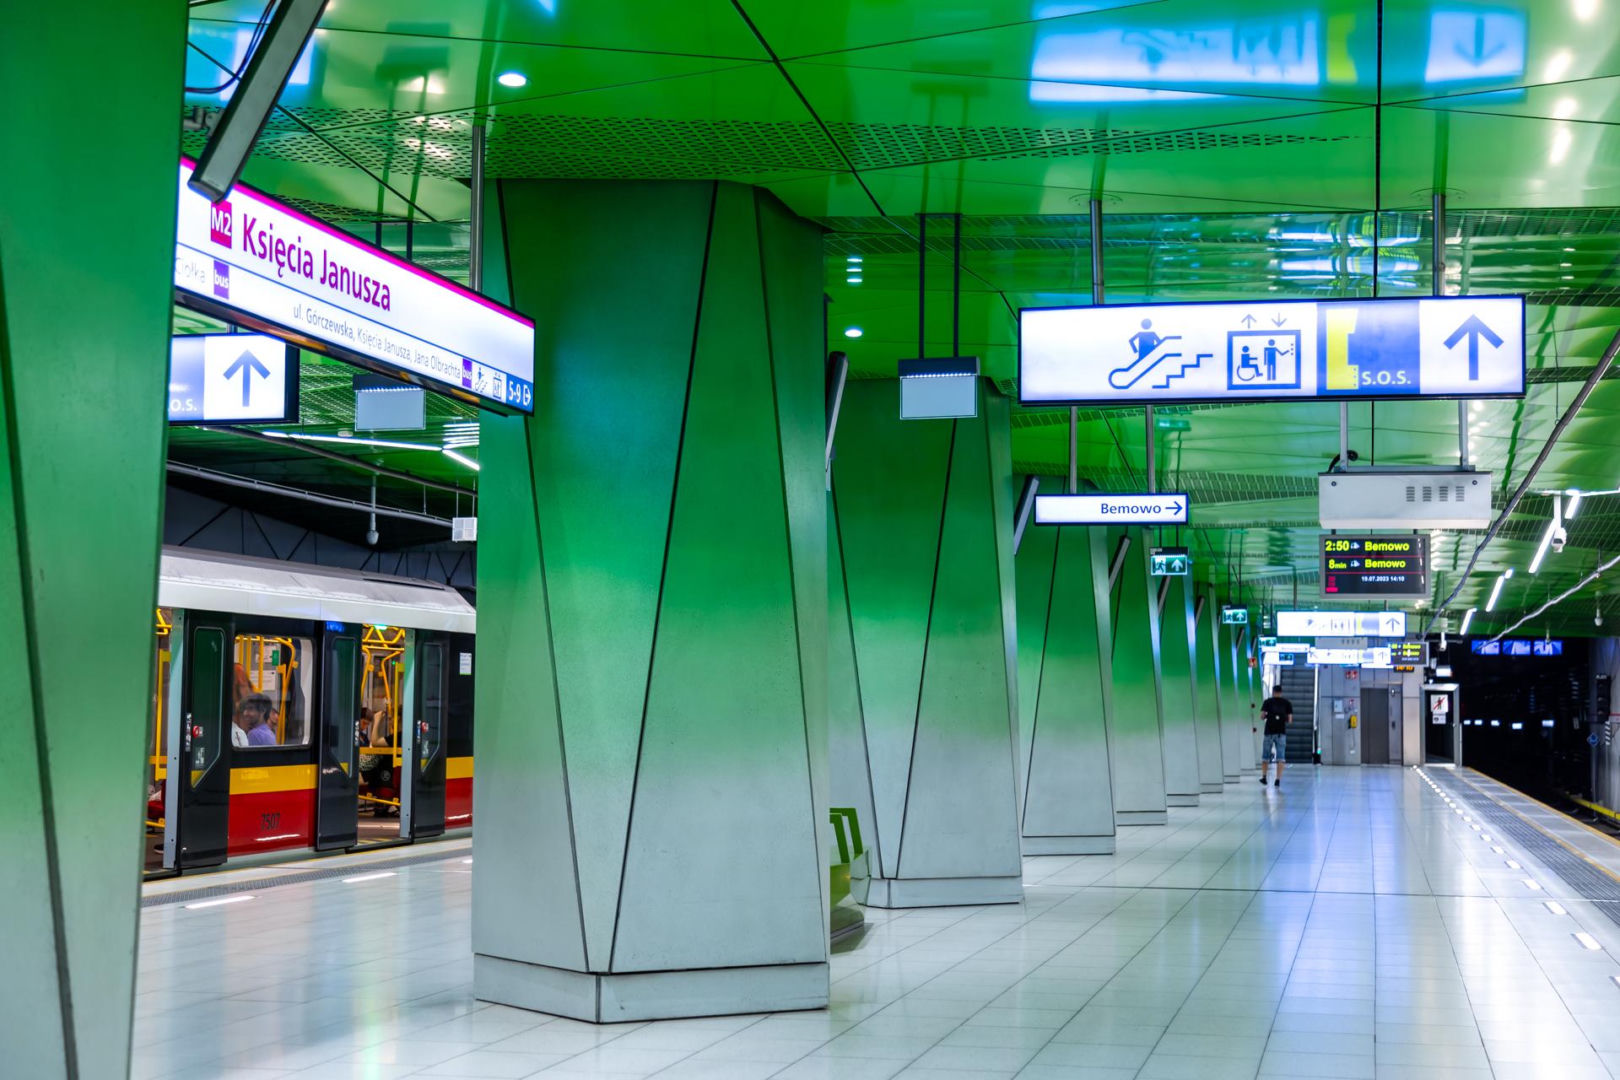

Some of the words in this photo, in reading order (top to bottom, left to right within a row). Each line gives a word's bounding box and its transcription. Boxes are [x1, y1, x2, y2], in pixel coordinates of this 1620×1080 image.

[211, 206, 232, 237] M2
[243, 213, 313, 280] Księcia
[320, 249, 391, 312] Janusza
[213, 268, 230, 289] bus
[293, 304, 304, 321] ul.
[306, 308, 356, 342] Górczewska,
[357, 327, 382, 351] Księcia
[383, 337, 413, 363] Janusza,
[414, 349, 429, 367] Jana
[430, 355, 461, 379] Olbrachta
[1362, 370, 1411, 385] S.O.S.
[508, 380, 521, 403] 5-9
[1101, 503, 1162, 514] Bemowo
[1325, 540, 1350, 551] 2:50
[1364, 541, 1410, 551] Bemowo
[1364, 559, 1406, 569] Bemowo
[260, 812, 281, 831] 7507
